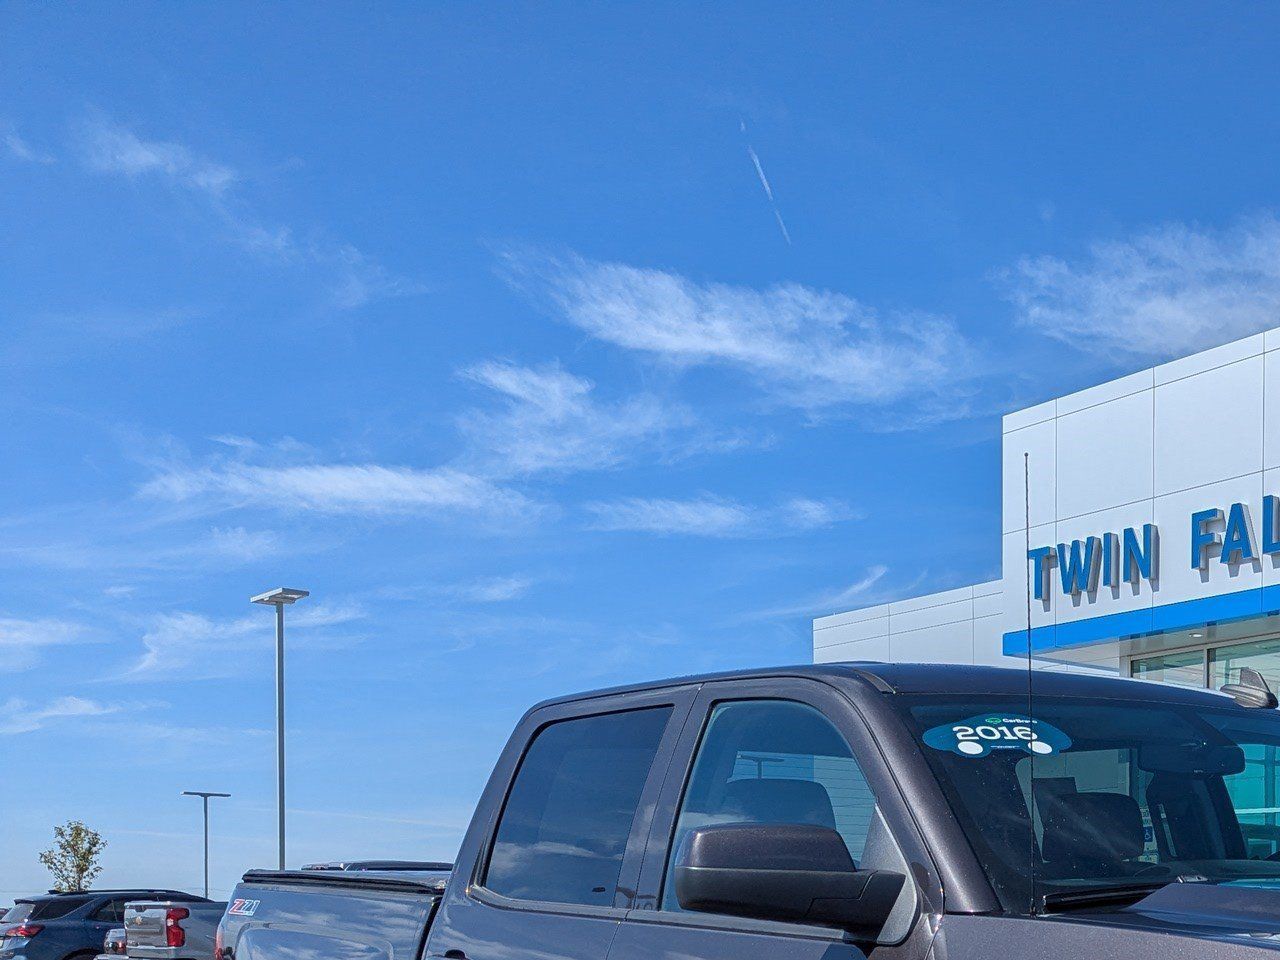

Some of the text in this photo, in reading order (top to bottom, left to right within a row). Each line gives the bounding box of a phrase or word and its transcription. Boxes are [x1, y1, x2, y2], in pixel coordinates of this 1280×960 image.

[1029, 523, 1160, 601] TWIN
[952, 725, 1038, 740] 2016
[228, 899, 261, 916] Z71
